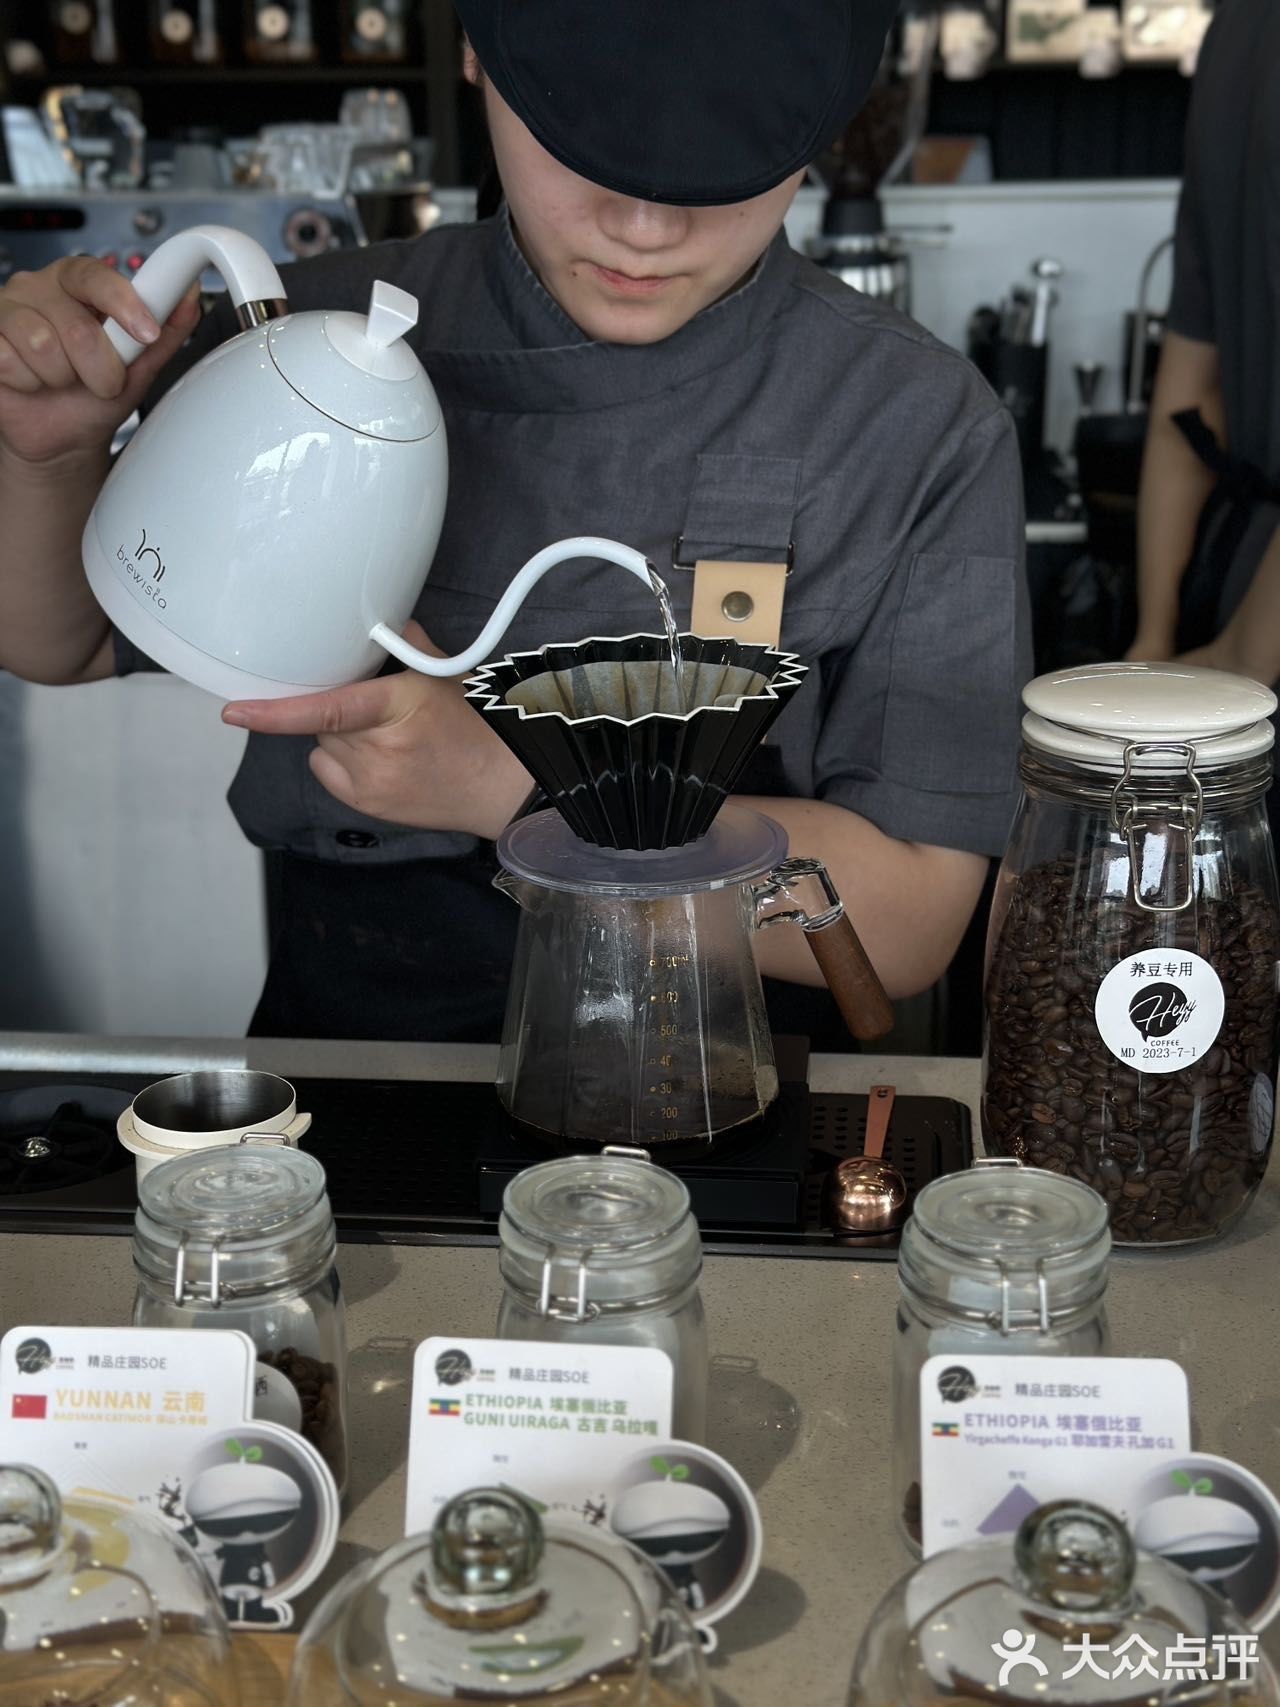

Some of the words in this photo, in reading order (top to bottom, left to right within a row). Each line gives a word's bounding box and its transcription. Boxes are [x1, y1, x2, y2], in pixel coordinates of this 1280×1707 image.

[1130, 961, 1193, 978] 养豆专用
[660, 1024, 678, 1036] 500
[1120, 1047, 1136, 1058] MD
[1142, 1047, 1196, 1059] 2023-7-1
[87, 1354, 168, 1370] 精品庄园SOE
[509, 1367, 590, 1384] 精品庄园SOE
[1015, 1383, 1101, 1398] 精品庄园SOE
[56, 1389, 152, 1409] YUNNAN
[163, 1391, 207, 1412] 云南
[465, 1393, 543, 1410] ETHIOPIA
[463, 1412, 505, 1427] GUNI
[964, 1413, 1049, 1429] ETHIOPIA
[1056, 1415, 1143, 1433] 埃塞俄比亚
